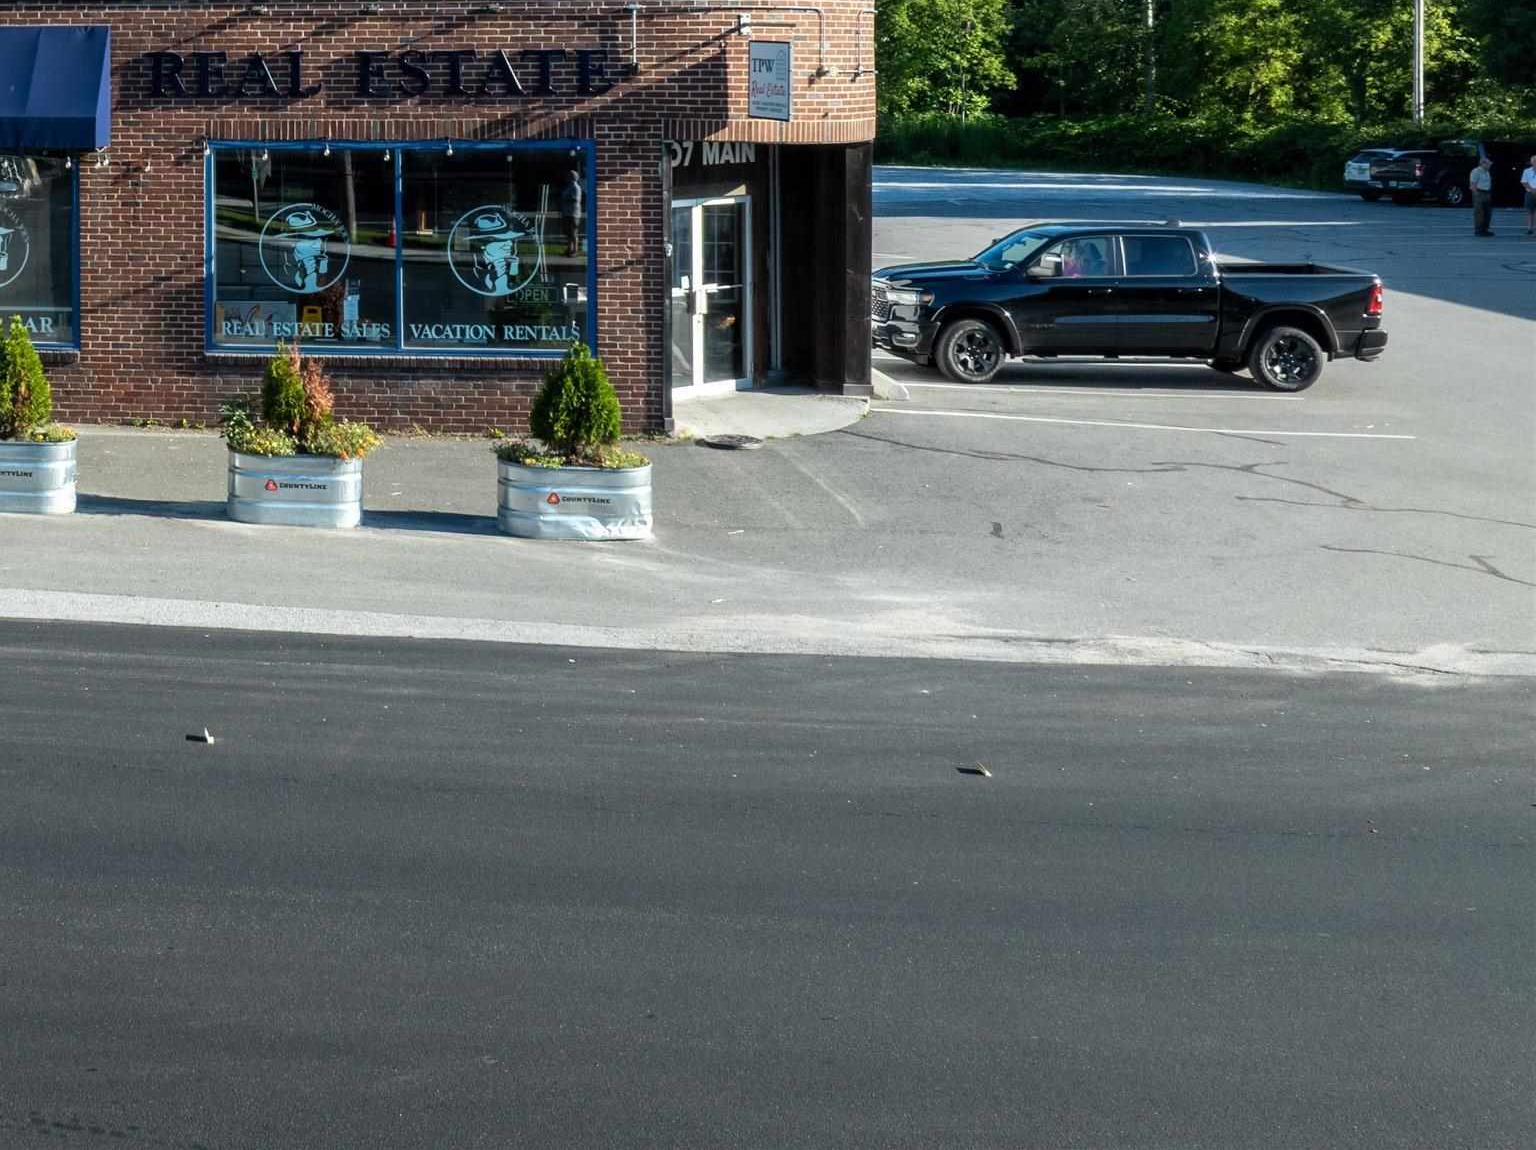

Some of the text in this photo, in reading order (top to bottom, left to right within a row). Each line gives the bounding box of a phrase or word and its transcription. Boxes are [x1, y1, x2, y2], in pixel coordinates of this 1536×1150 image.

[751, 57, 776, 73] TPW
[142, 49, 615, 99] REAL ESTATE
[702, 141, 756, 166] MAIN
[11, 316, 54, 333] AR
[221, 320, 391, 338] REAL ESTATE SALES
[409, 323, 580, 340] VACATION RENTALS
